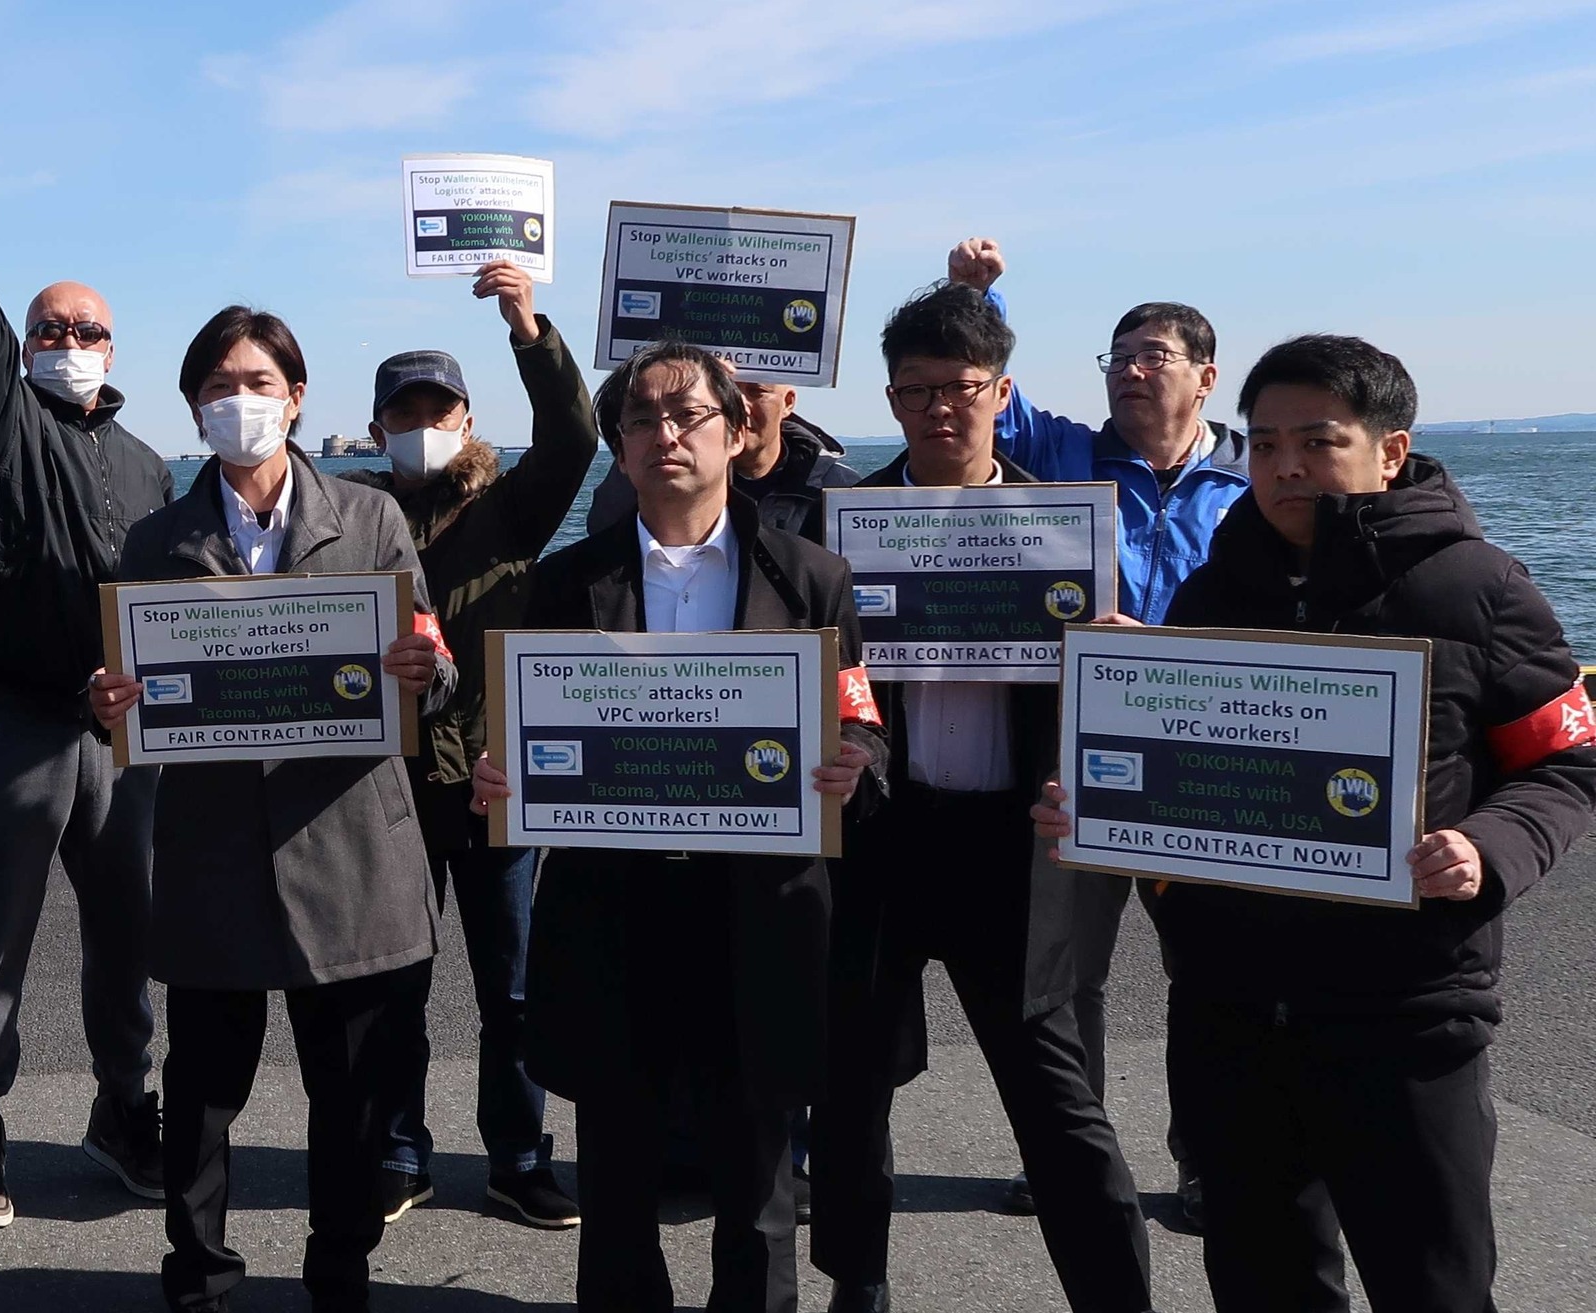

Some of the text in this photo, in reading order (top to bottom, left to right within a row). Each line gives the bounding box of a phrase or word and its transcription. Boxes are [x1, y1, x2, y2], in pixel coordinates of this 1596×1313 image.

[419, 175, 440, 185] Stop
[453, 198, 473, 207] VPC
[460, 214, 514, 223] YOKOHAMA
[463, 225, 514, 235] stands with
[509, 238, 525, 248] USA
[628, 229, 820, 252] Stop Wallenius Wilhelmsen
[715, 253, 765, 266] attacks
[768, 258, 787, 268] on
[674, 266, 768, 284] VPC workers!
[682, 290, 764, 306] YOKOHAMA
[729, 311, 760, 325] with
[751, 331, 779, 343] USA
[757, 354, 803, 367] NOW!
[851, 512, 1081, 531] Stop Wallenius Wilhelmsen
[957, 532, 1016, 547] attacks
[1020, 535, 1042, 546] on
[909, 552, 1021, 567] VPC workers!
[922, 579, 1020, 593] YOKOHAMA
[142, 600, 365, 624] Stop Wallenius Wilhelmsen
[924, 599, 1018, 614] stands with
[247, 621, 304, 636] attacks
[308, 623, 329, 633] on
[1009, 620, 1043, 634] USA
[201, 639, 309, 657] VPC workers!
[868, 646, 1013, 660] FAIR CONTRACT
[215, 665, 310, 680] YOKOHAMA
[532, 660, 784, 679] Stop Wallenius Wilhelmsen
[1092, 663, 1378, 698] Stop Wallenius Wilhelmsen
[219, 683, 308, 700] stands with
[648, 683, 713, 699] attacks
[718, 687, 742, 699] on
[196, 702, 333, 720] Tacoma, WA, USA
[596, 705, 718, 722] VPC workers!
[1220, 698, 1294, 718] attacks
[1300, 706, 1327, 720] on
[168, 724, 364, 744] FAIR CONTRACT NOW!
[1161, 716, 1299, 744] VPC workers!
[610, 735, 718, 751] YOKOHAMA
[613, 759, 715, 775] stands with
[1175, 750, 1296, 777] YOKOHAMA
[586, 782, 743, 800] Tacoma, WA, USA
[1177, 778, 1292, 804] stands with
[552, 809, 778, 828] FAIR CONTRACT NOW!
[1147, 799, 1323, 832] Tacoma, WA, USA
[1108, 826, 1362, 869] FAIR CONTRACT NOW!
